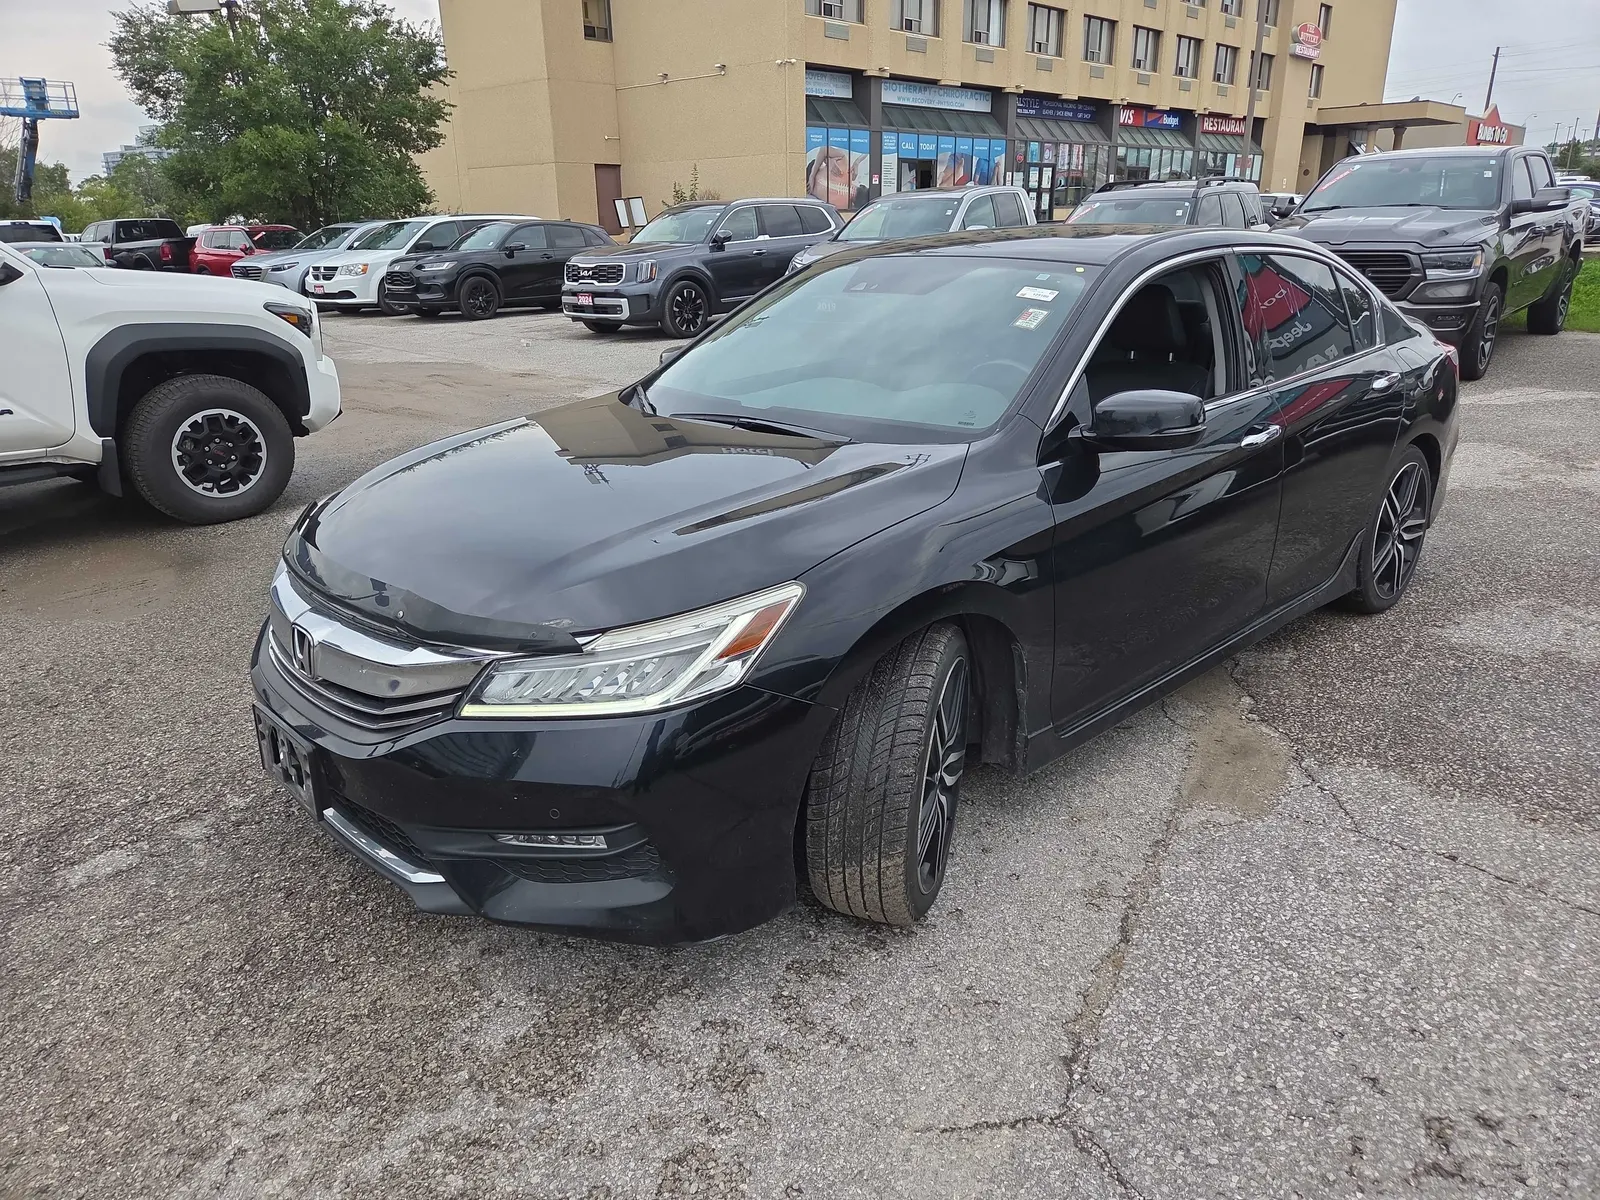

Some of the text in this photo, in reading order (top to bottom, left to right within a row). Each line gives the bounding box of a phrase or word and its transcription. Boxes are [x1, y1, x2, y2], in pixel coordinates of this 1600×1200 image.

[1295, 45, 1320, 58] RESTAURANT
[937, 88, 990, 102] CHIROPRACTIC
[1163, 114, 1179, 128] Budget
[1477, 123, 1494, 141] BLINDS
[901, 142, 915, 150] CALL
[920, 143, 937, 151] TODAY
[578, 295, 593, 303] 2024
